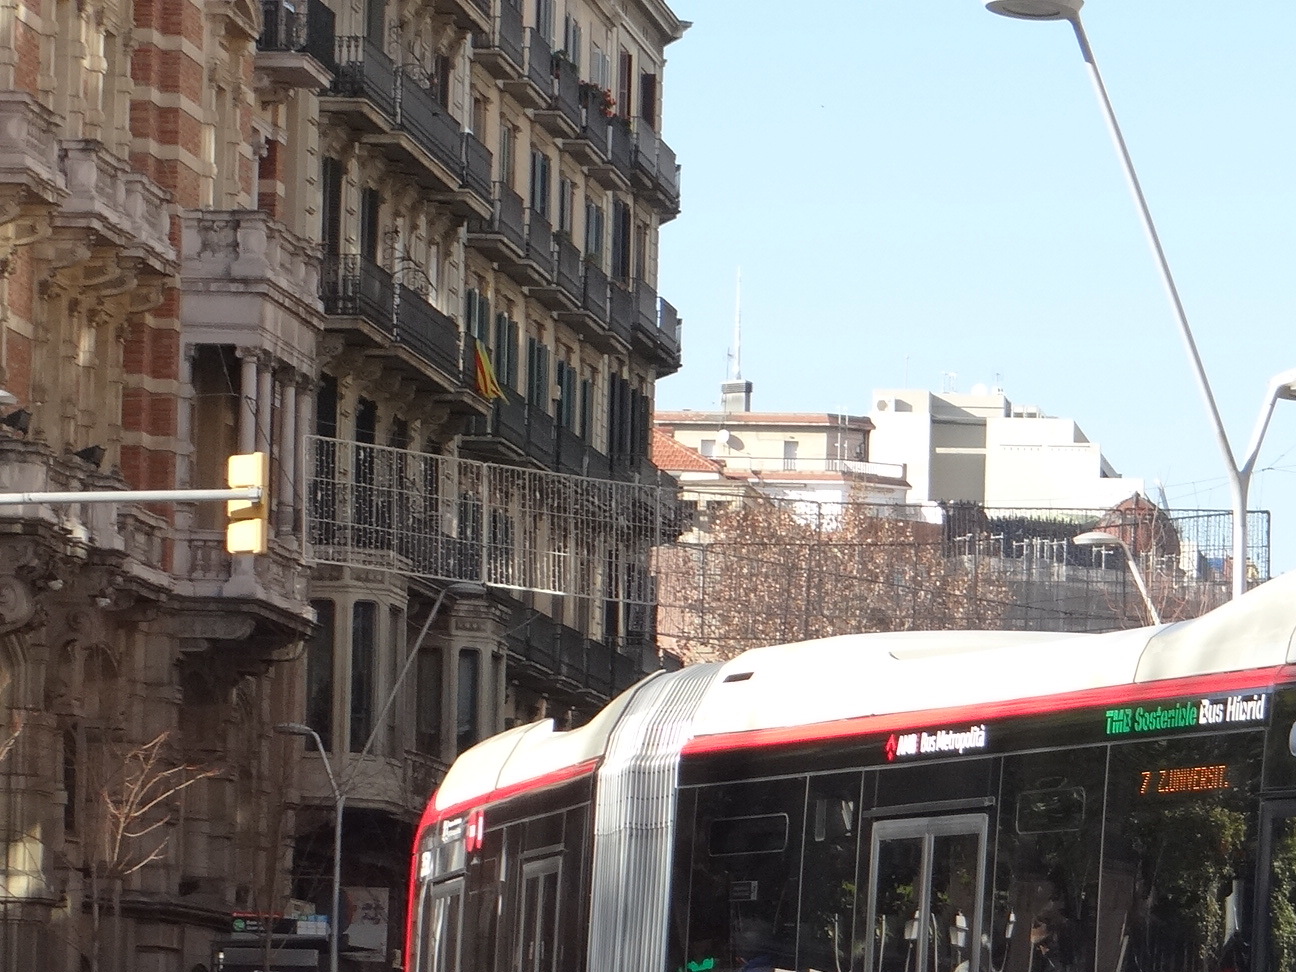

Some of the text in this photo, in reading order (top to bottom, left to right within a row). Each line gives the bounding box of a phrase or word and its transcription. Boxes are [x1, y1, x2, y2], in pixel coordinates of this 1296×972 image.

[1106, 708, 1132, 734] TMB
[1134, 702, 1197, 732] Sostenible
[1198, 698, 1224, 725] Bus
[1139, 770, 1151, 795] 7
